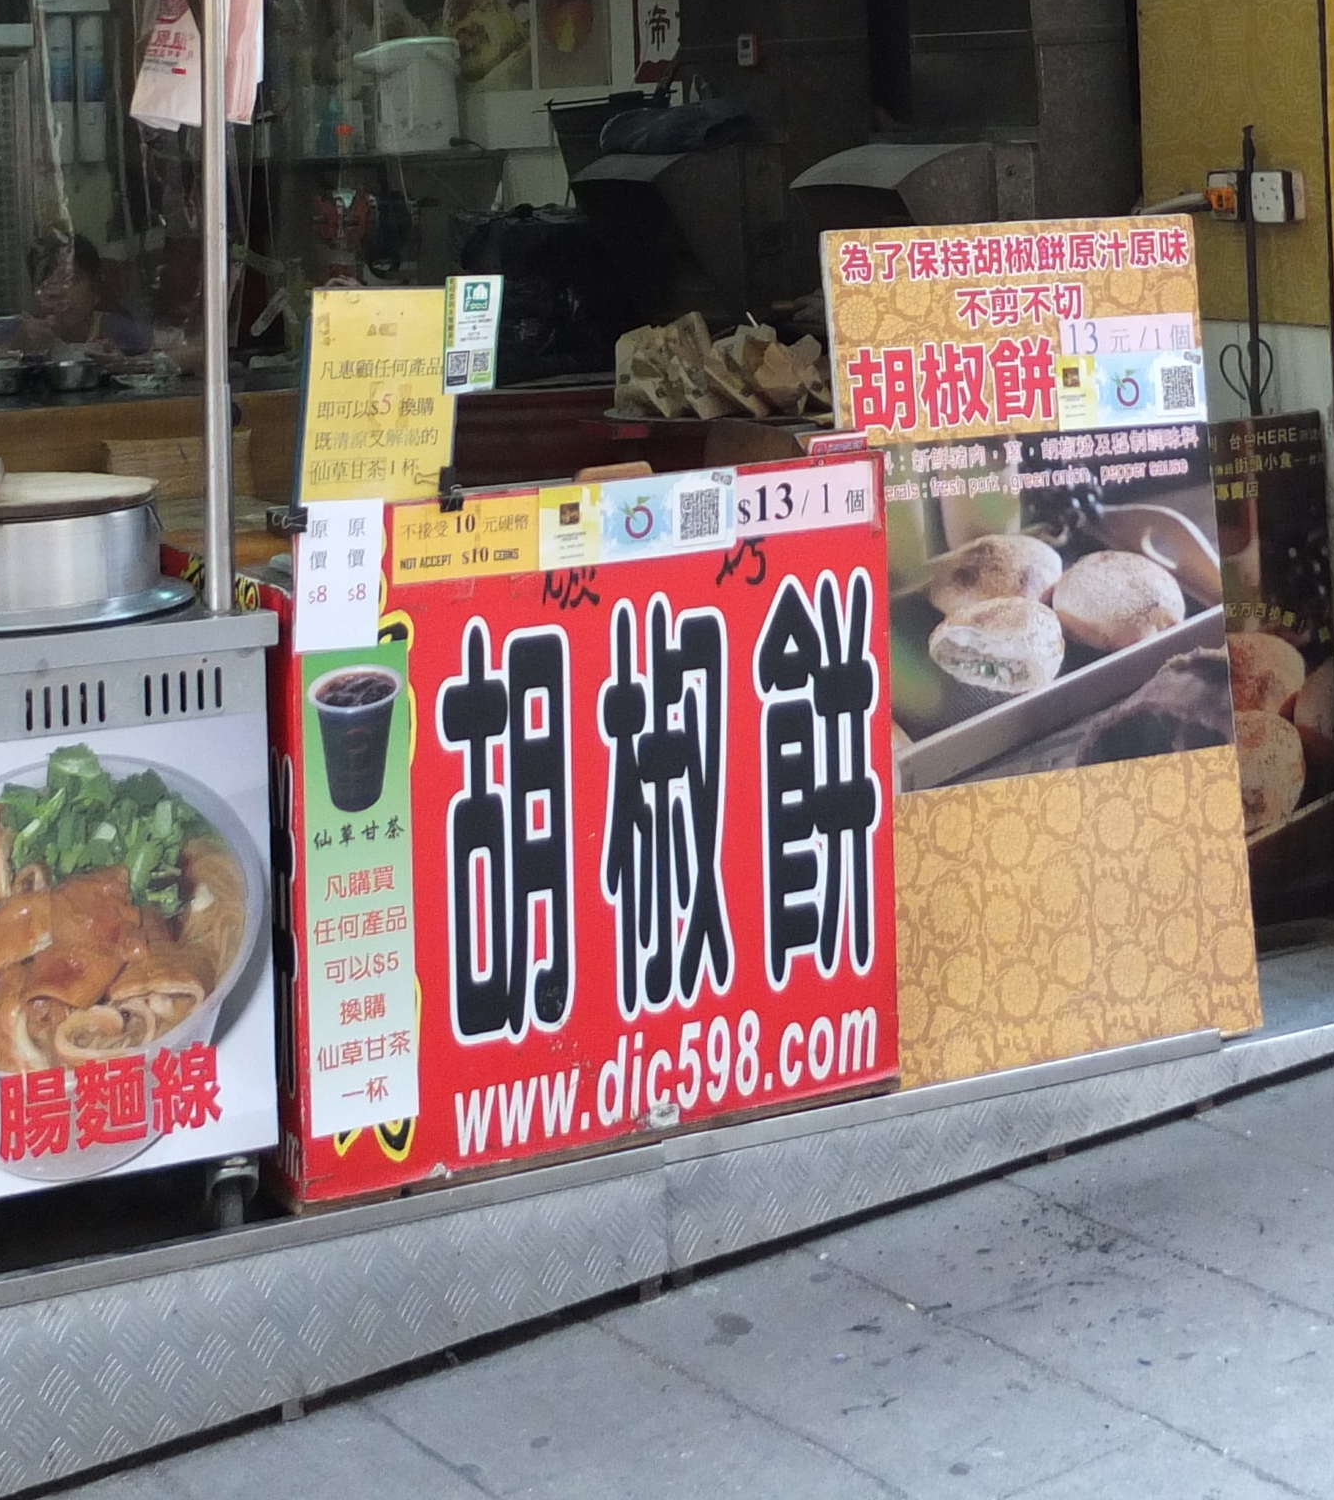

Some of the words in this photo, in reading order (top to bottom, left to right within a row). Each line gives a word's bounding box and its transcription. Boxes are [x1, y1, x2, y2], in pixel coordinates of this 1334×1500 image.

[840, 226, 1189, 284] 為了保持胡椒餅原汁原味
[956, 283, 1085, 329] 不剪不切
[847, 336, 1057, 434] 胡椒餅
[400, 520, 449, 540] 不接受
[436, 566, 878, 1046] 胡椒餅
[313, 815, 405, 851] 仙草甘茶
[324, 864, 396, 902] 凡購買
[313, 905, 408, 946] 任何產品
[324, 952, 400, 985] 可以$5
[339, 992, 387, 1023] 換購
[316, 1027, 411, 1072] 仙草甘茶
[340, 1076, 390, 1106] 一杯
